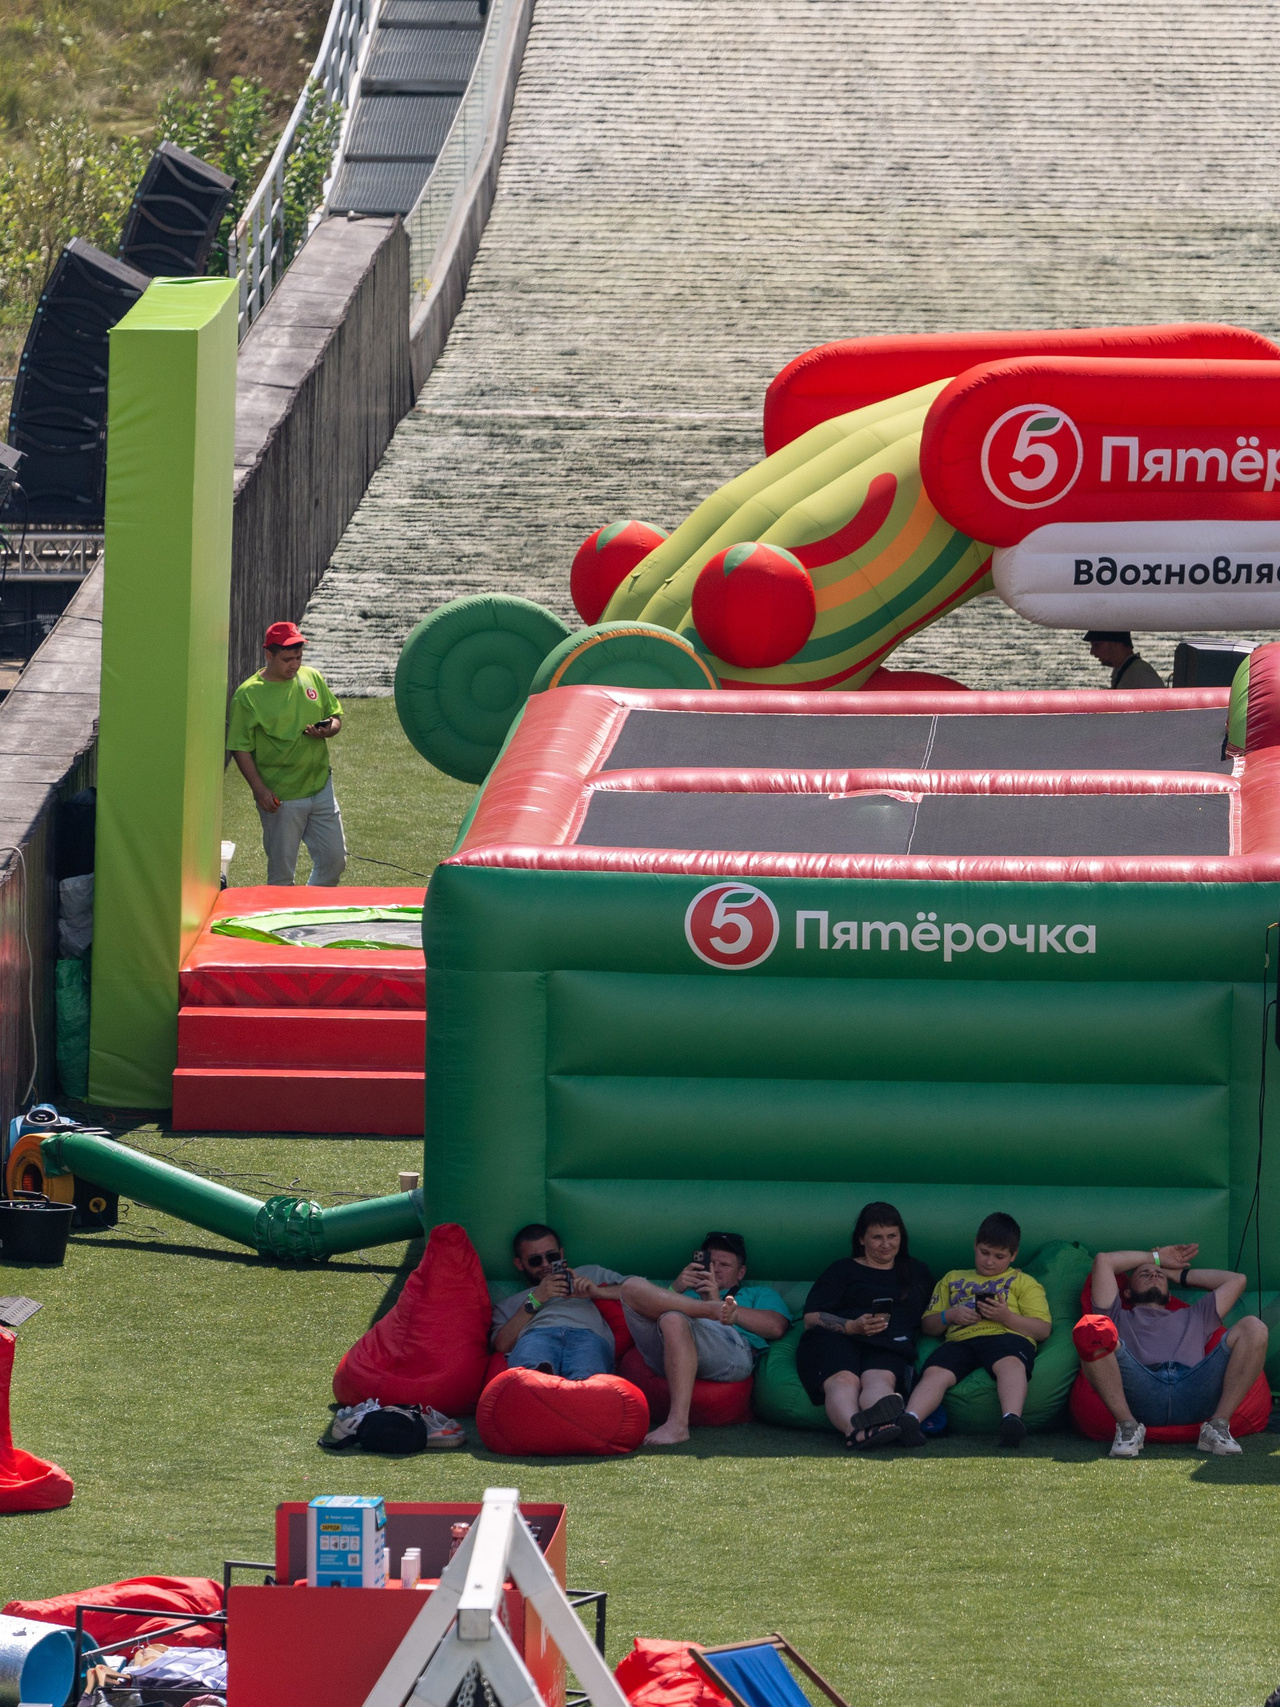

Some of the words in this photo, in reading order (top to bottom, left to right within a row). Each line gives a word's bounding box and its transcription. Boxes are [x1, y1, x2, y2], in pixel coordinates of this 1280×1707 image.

[1008, 412, 1064, 491] 5
[709, 888, 760, 955] 5
[796, 911, 1097, 962] Пятёрочка
